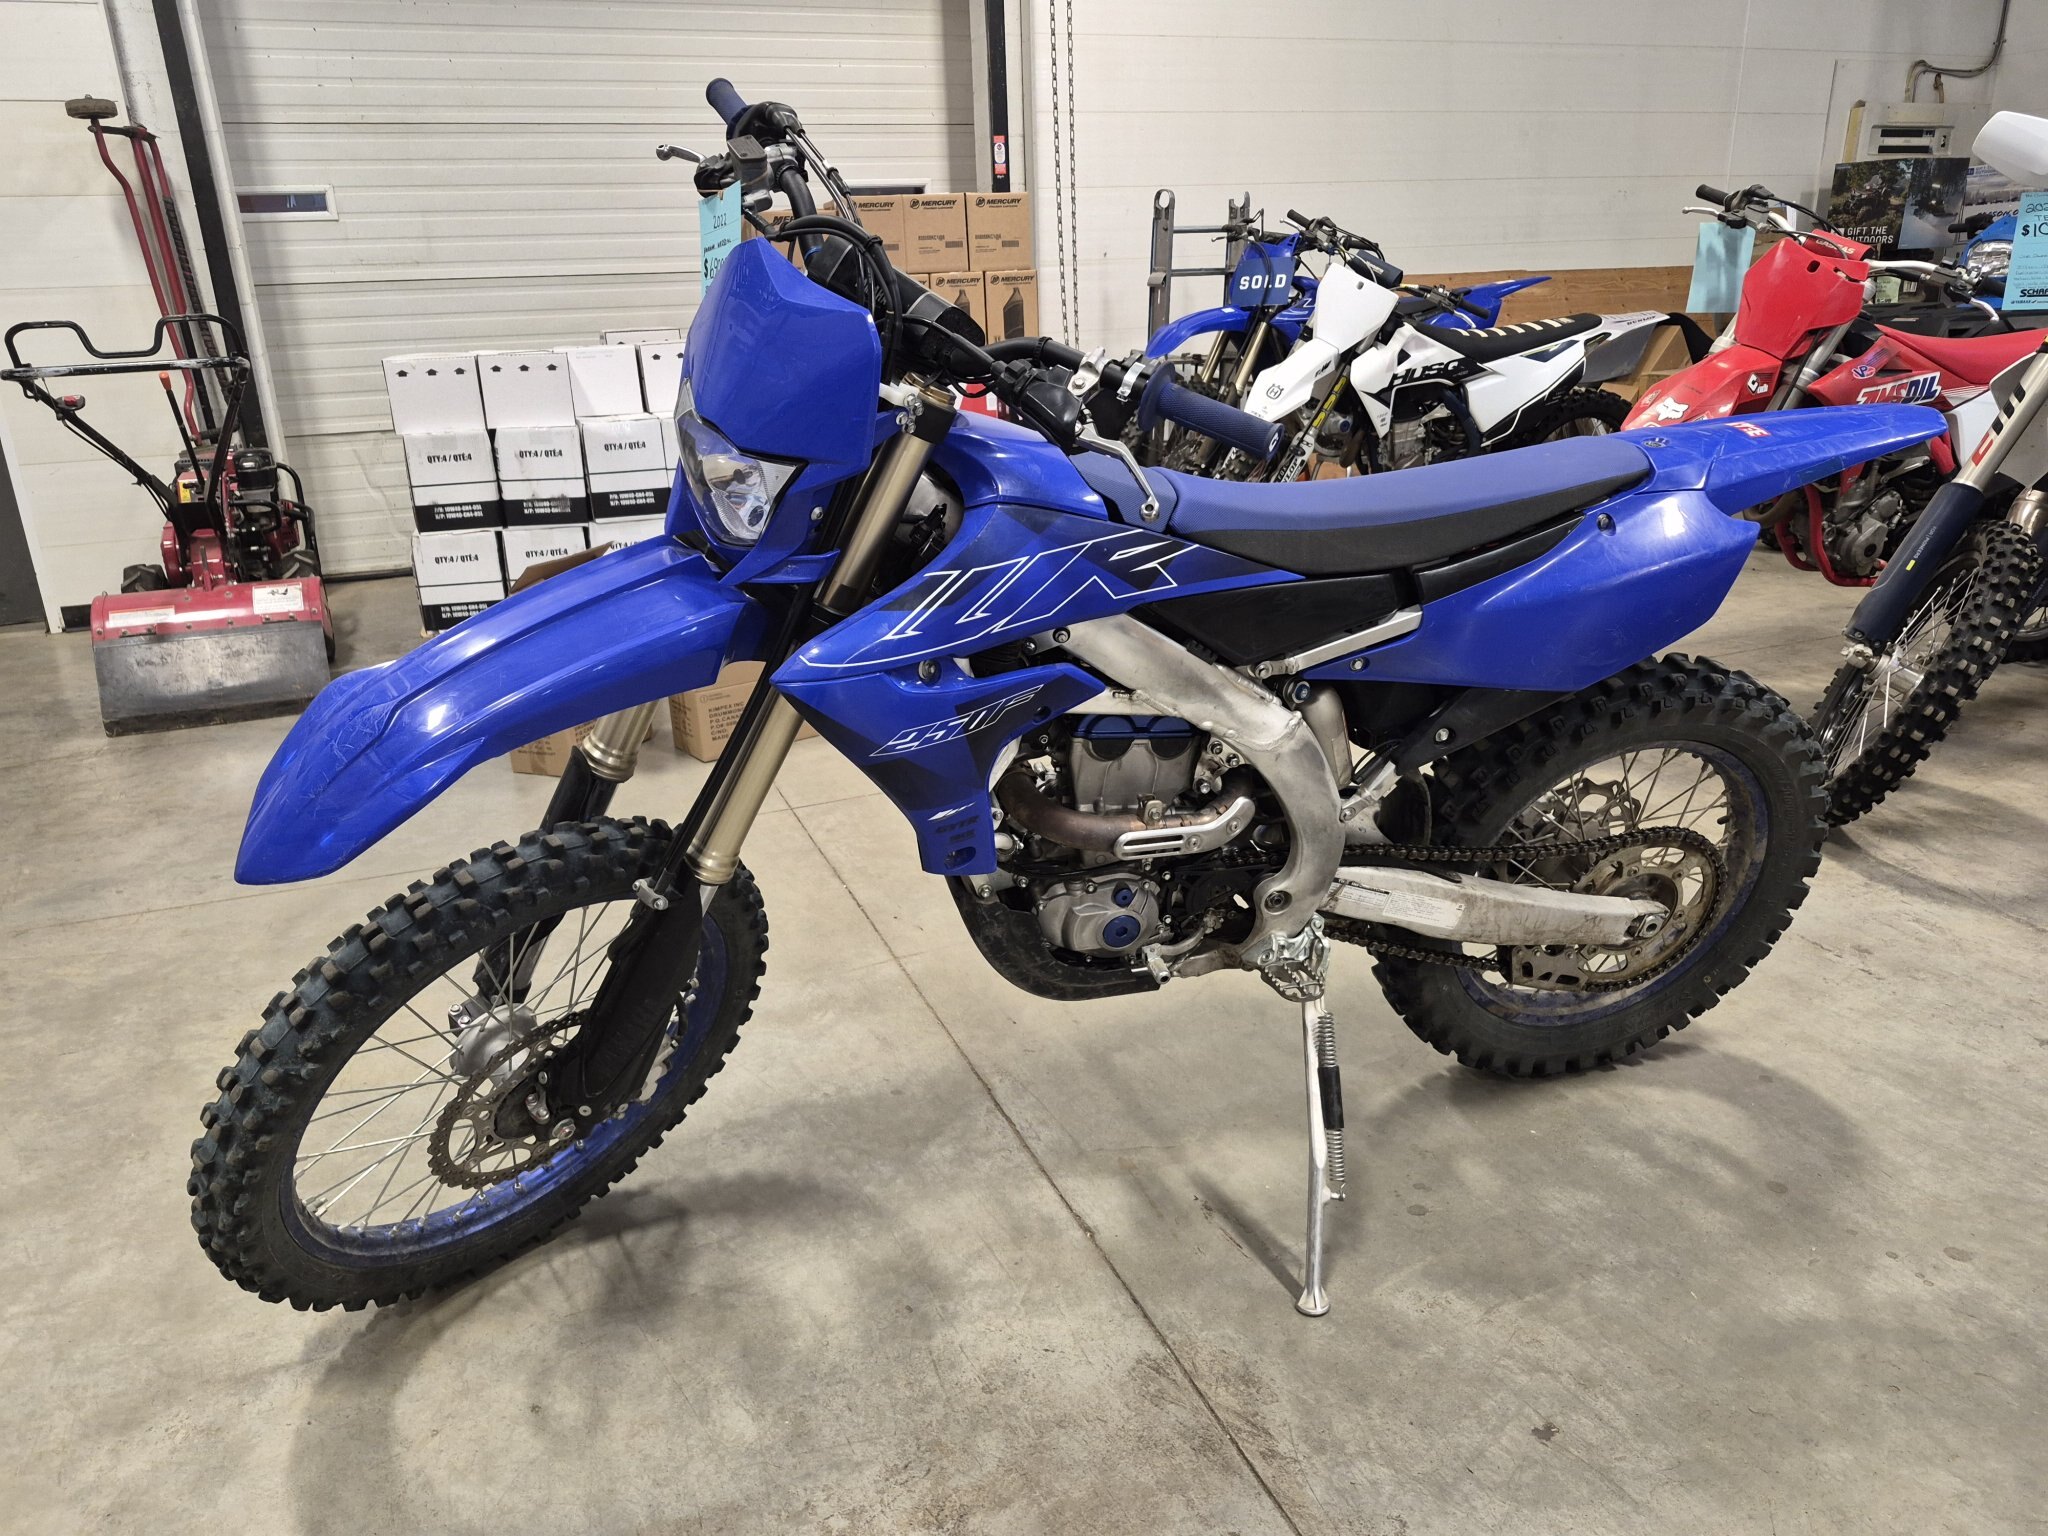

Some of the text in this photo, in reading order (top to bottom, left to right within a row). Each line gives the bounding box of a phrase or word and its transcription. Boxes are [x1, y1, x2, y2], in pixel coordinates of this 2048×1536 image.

[858, 201, 895, 209] MERCURY
[921, 199, 957, 207] MERCURY
[986, 198, 1022, 206] MERCURY
[713, 213, 727, 229] 2022
[1847, 226, 1888, 236] GIFT THE
[947, 277, 981, 285] MERCURY
[1000, 275, 1035, 283] MERCURY
[1239, 274, 1287, 290] SOLD
[1859, 374, 1940, 404] AMSOIL
[604, 442, 623, 452] QTY:4
[427, 454, 447, 464] QTY:4
[453, 452, 472, 463] QTÉ:4
[519, 450, 538, 459] QTY:4
[525, 550, 544, 559] QTY:4
[550, 548, 568, 557] QTÉ:4
[435, 556, 454, 565] QTY:4
[460, 553, 479, 563] QTÉ:4
[708, 704, 732, 713] KIMPEX
[869, 684, 1044, 757] 250F
